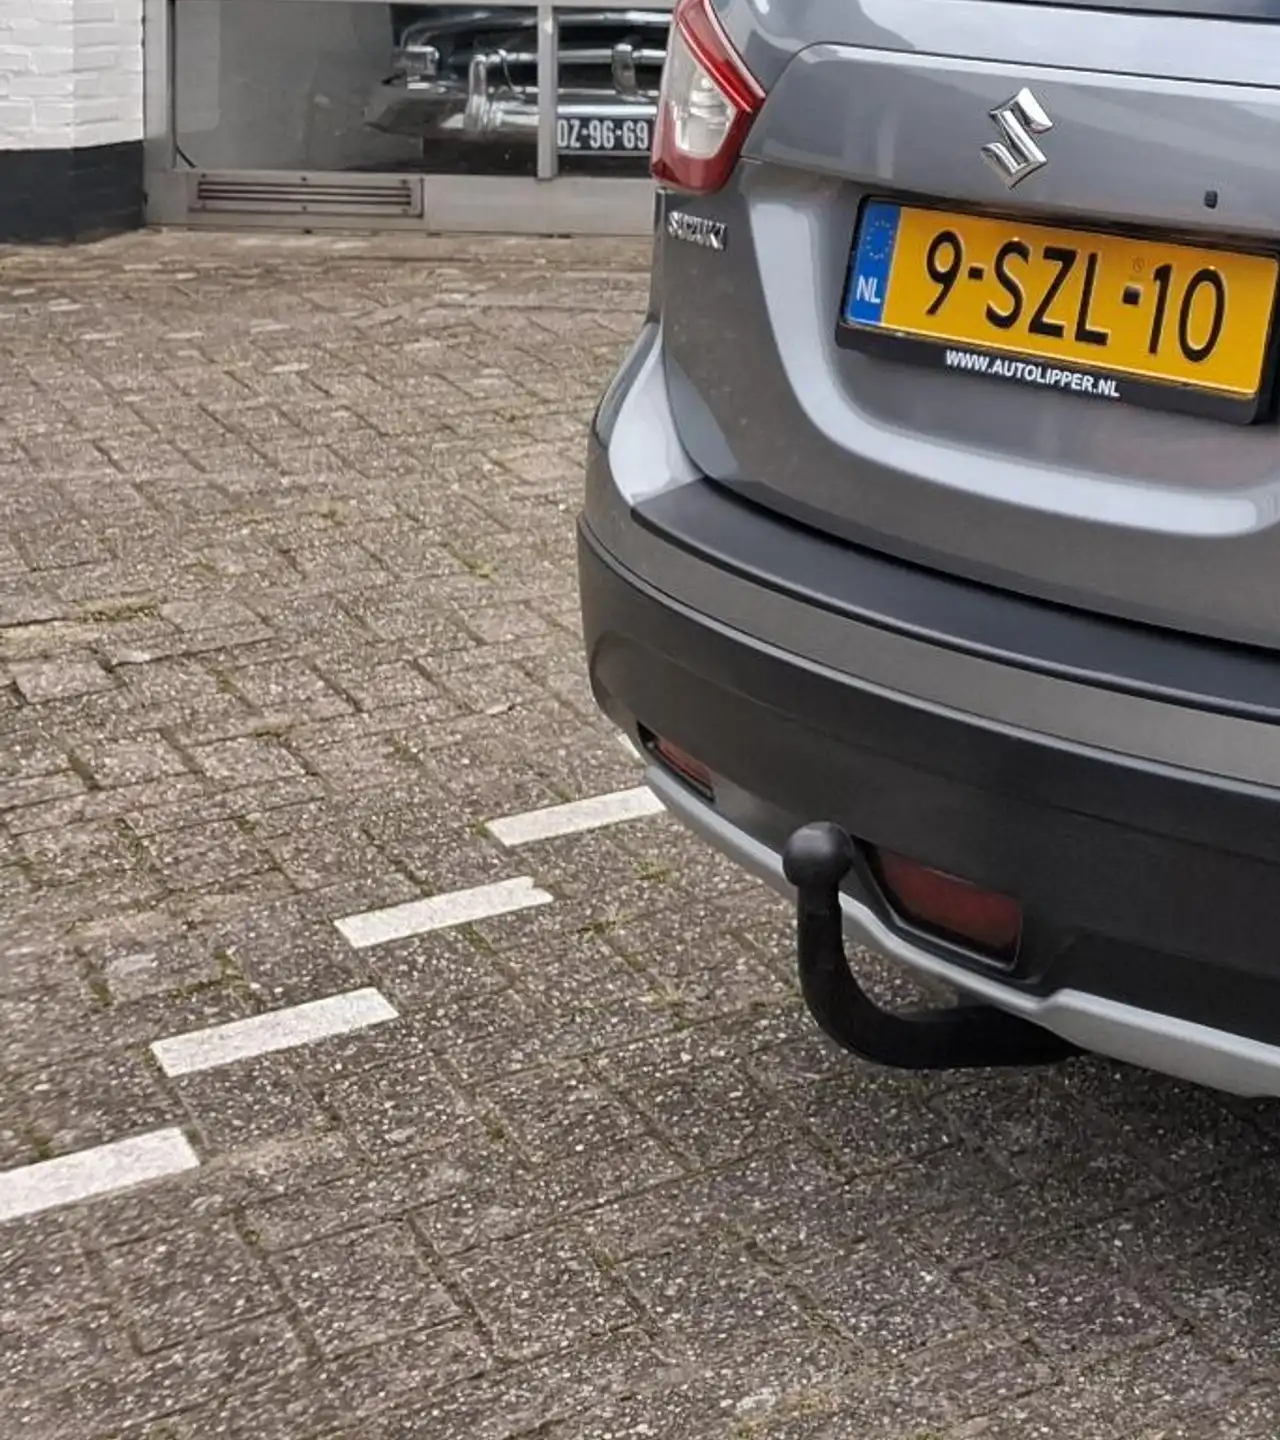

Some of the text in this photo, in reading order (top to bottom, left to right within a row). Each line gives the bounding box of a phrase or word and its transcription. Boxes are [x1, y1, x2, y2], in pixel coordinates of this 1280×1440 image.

[856, 274, 881, 305] NL
[925, 229, 1226, 363] 9-SZL-10
[945, 348, 1121, 398] WWW.AUTOLIPPER.NL
